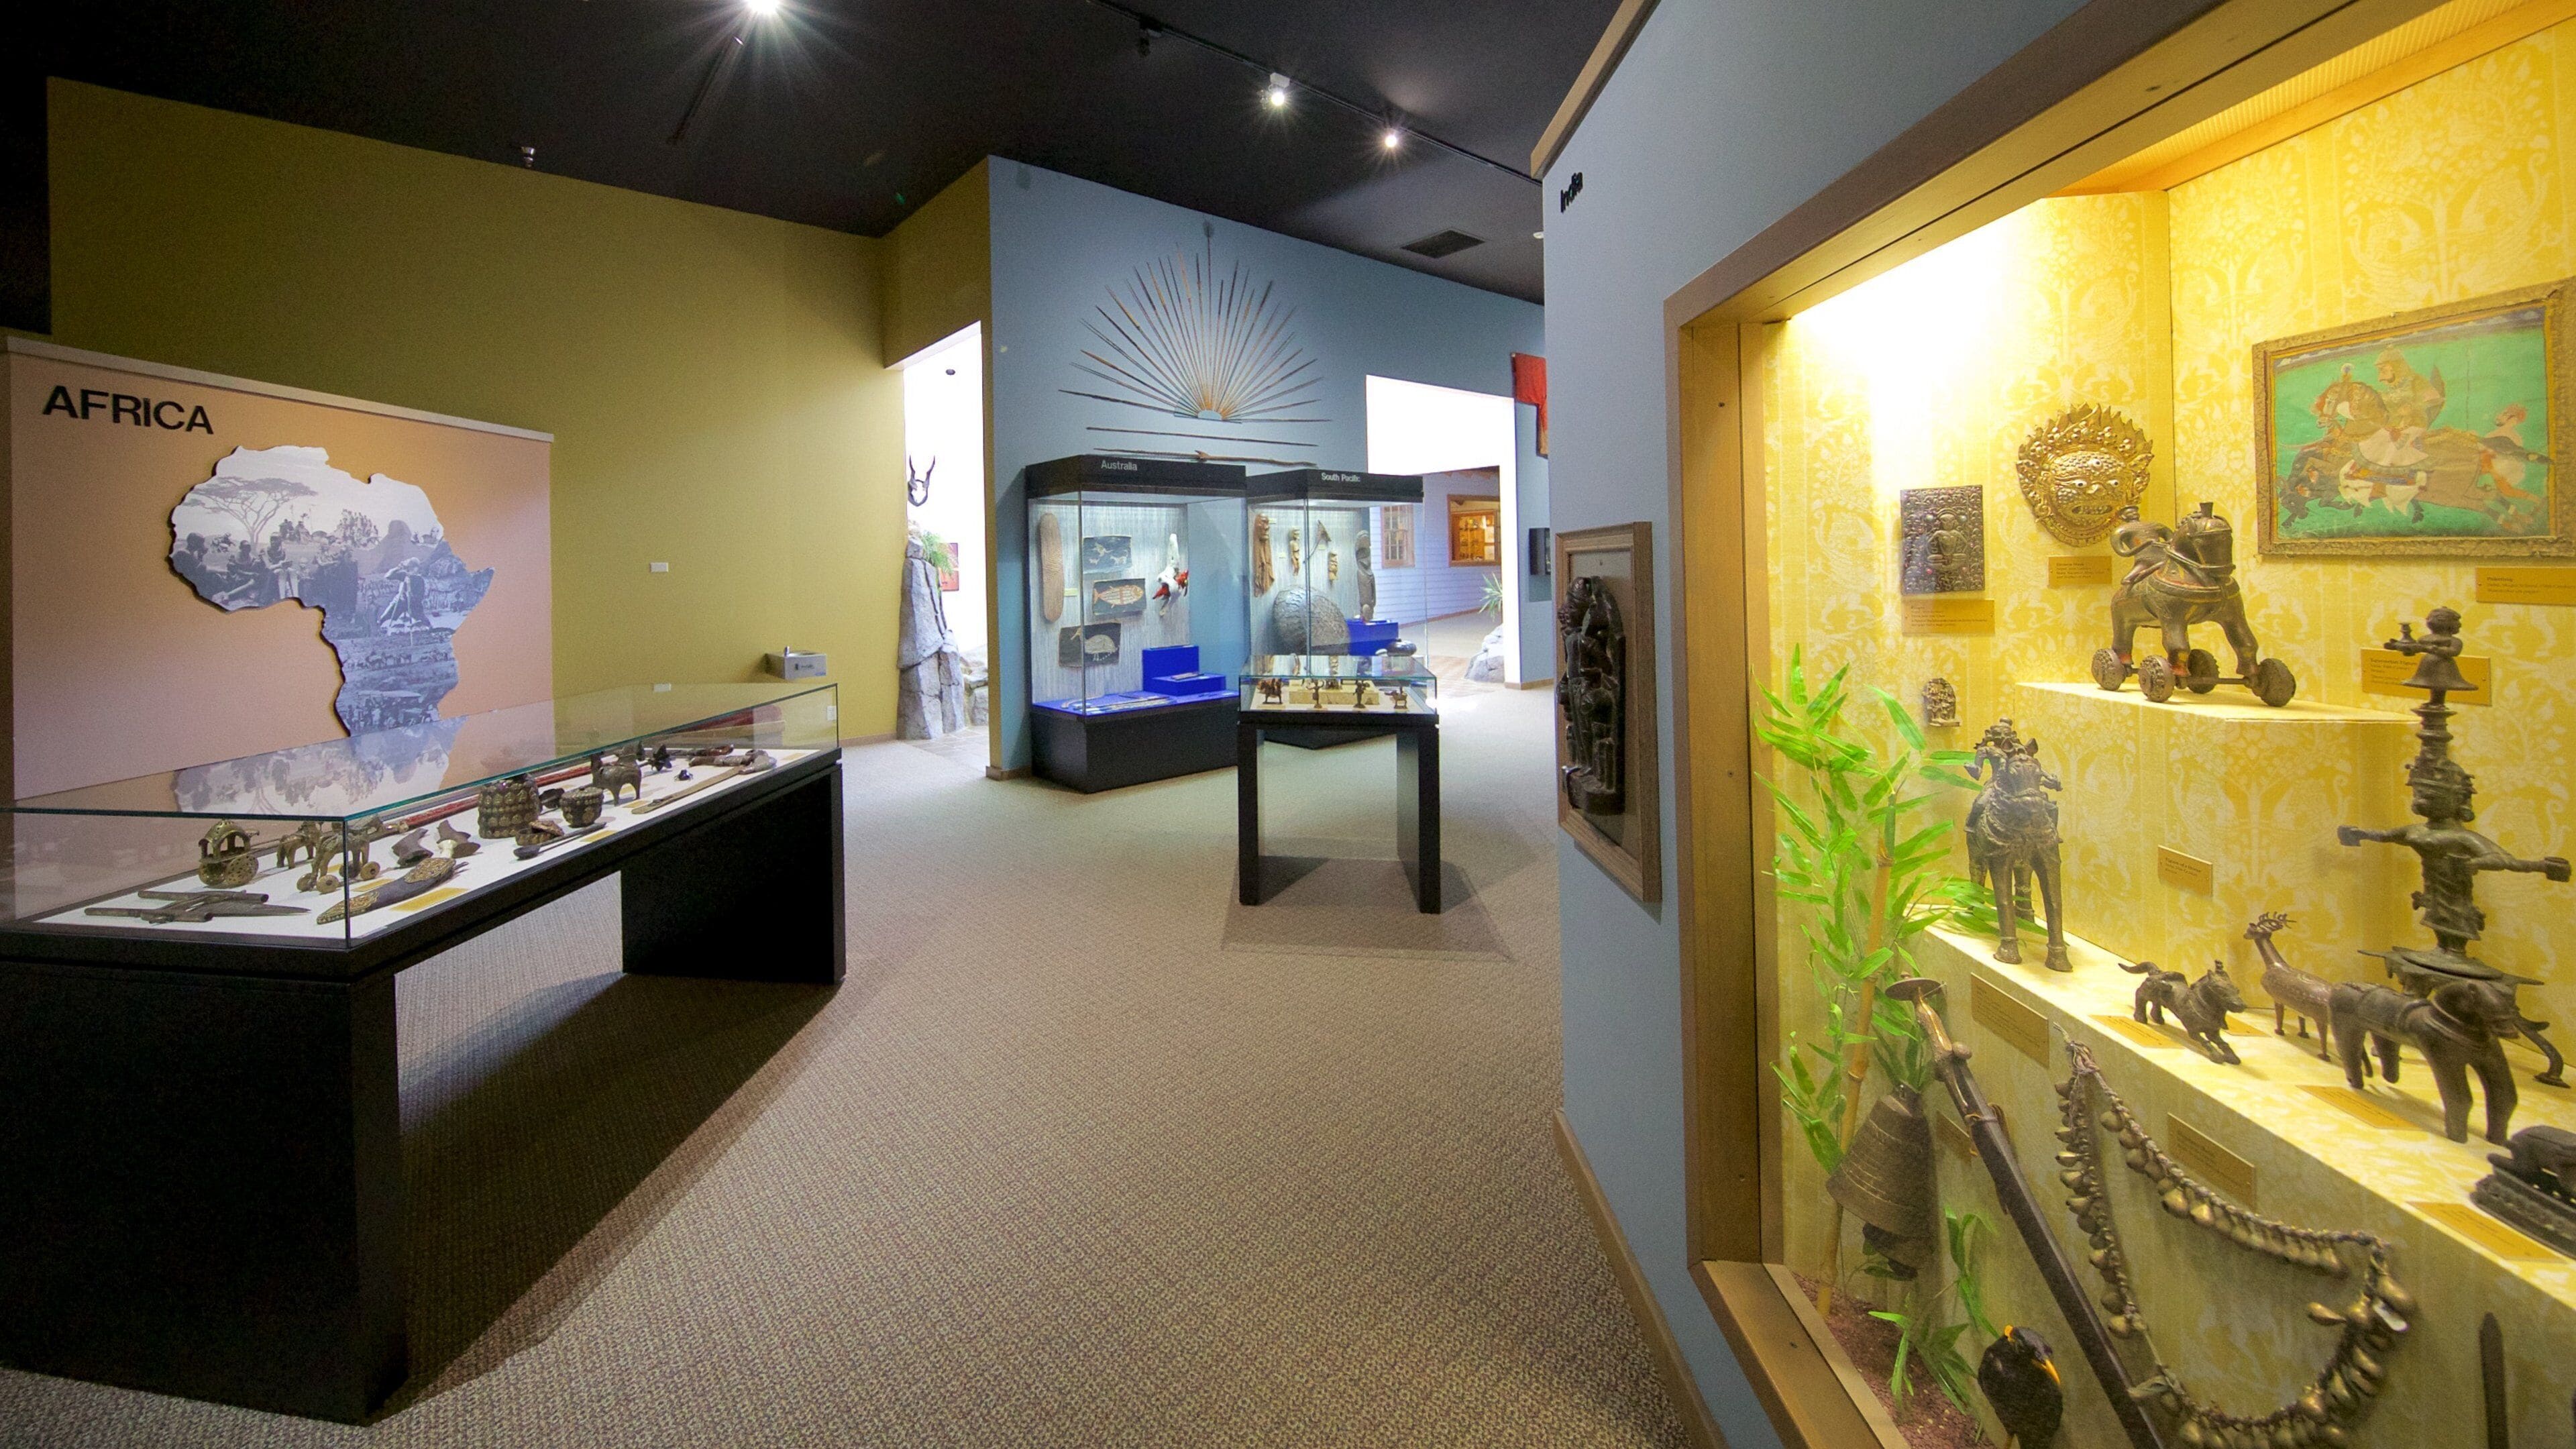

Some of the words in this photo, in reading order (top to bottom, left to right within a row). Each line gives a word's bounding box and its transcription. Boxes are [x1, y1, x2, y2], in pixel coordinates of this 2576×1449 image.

[1560, 172, 1583, 214] India
[42, 385, 214, 435] AFRICA
[1101, 460, 1138, 471] Australia
[1321, 472, 1340, 482] South
[1342, 474, 1361, 482] Pacific
